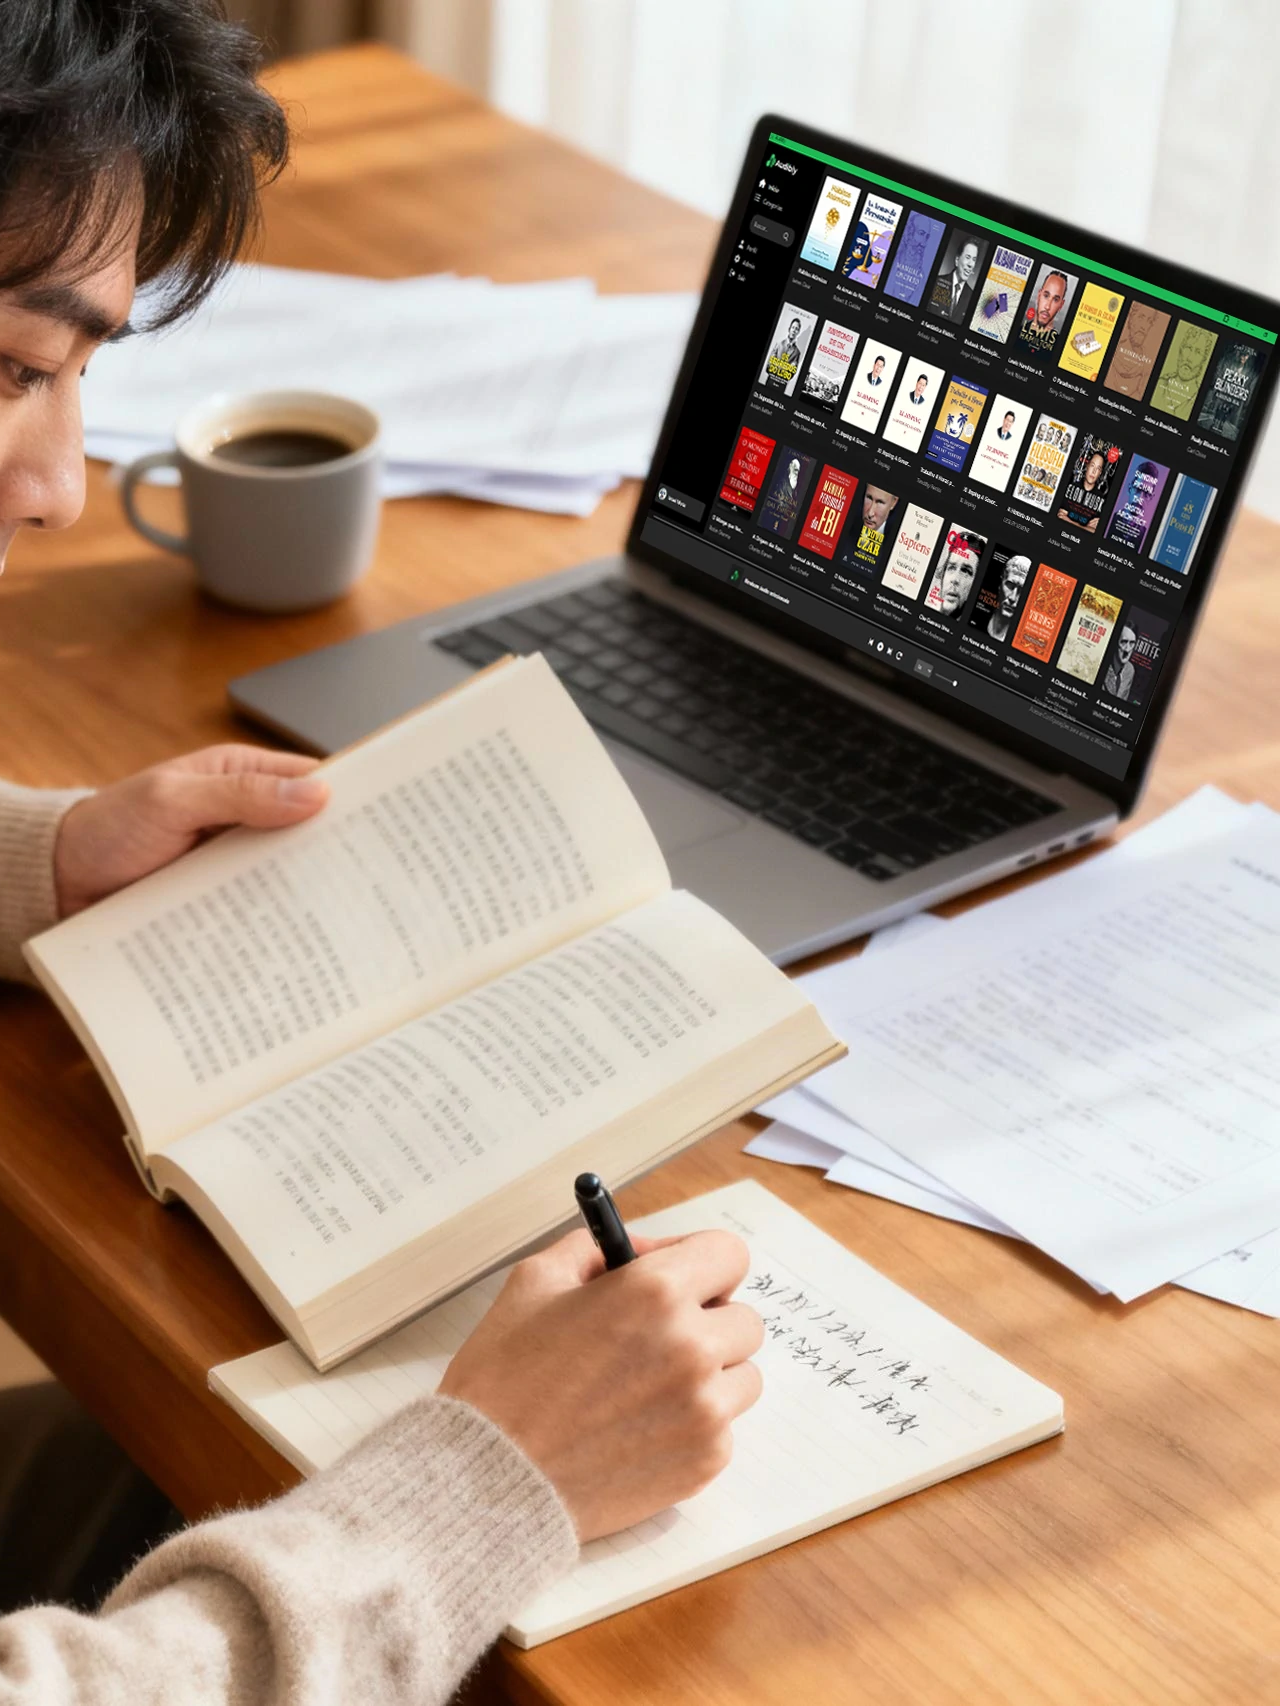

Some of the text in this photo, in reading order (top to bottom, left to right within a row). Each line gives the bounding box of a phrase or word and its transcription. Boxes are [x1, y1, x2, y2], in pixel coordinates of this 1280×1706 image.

[775, 159, 798, 176] Audibly
[1019, 331, 1053, 351] HAMILTON
[1021, 319, 1057, 344] LEWIS
[1223, 368, 1248, 387] PEAKY
[1213, 377, 1249, 401] BLINDERS
[1029, 441, 1065, 468] FILOSOFIA
[729, 477, 754, 494] FERRARI
[1134, 470, 1158, 485] SUNDAR
[1064, 483, 1084, 503] ELON
[1083, 492, 1104, 512] MUSK
[817, 506, 840, 537] FBI
[856, 536, 880, 556] CZAR
[896, 531, 932, 559] Sapiens
[946, 529, 970, 551] Che
[1027, 609, 1056, 629] VIKINGS
